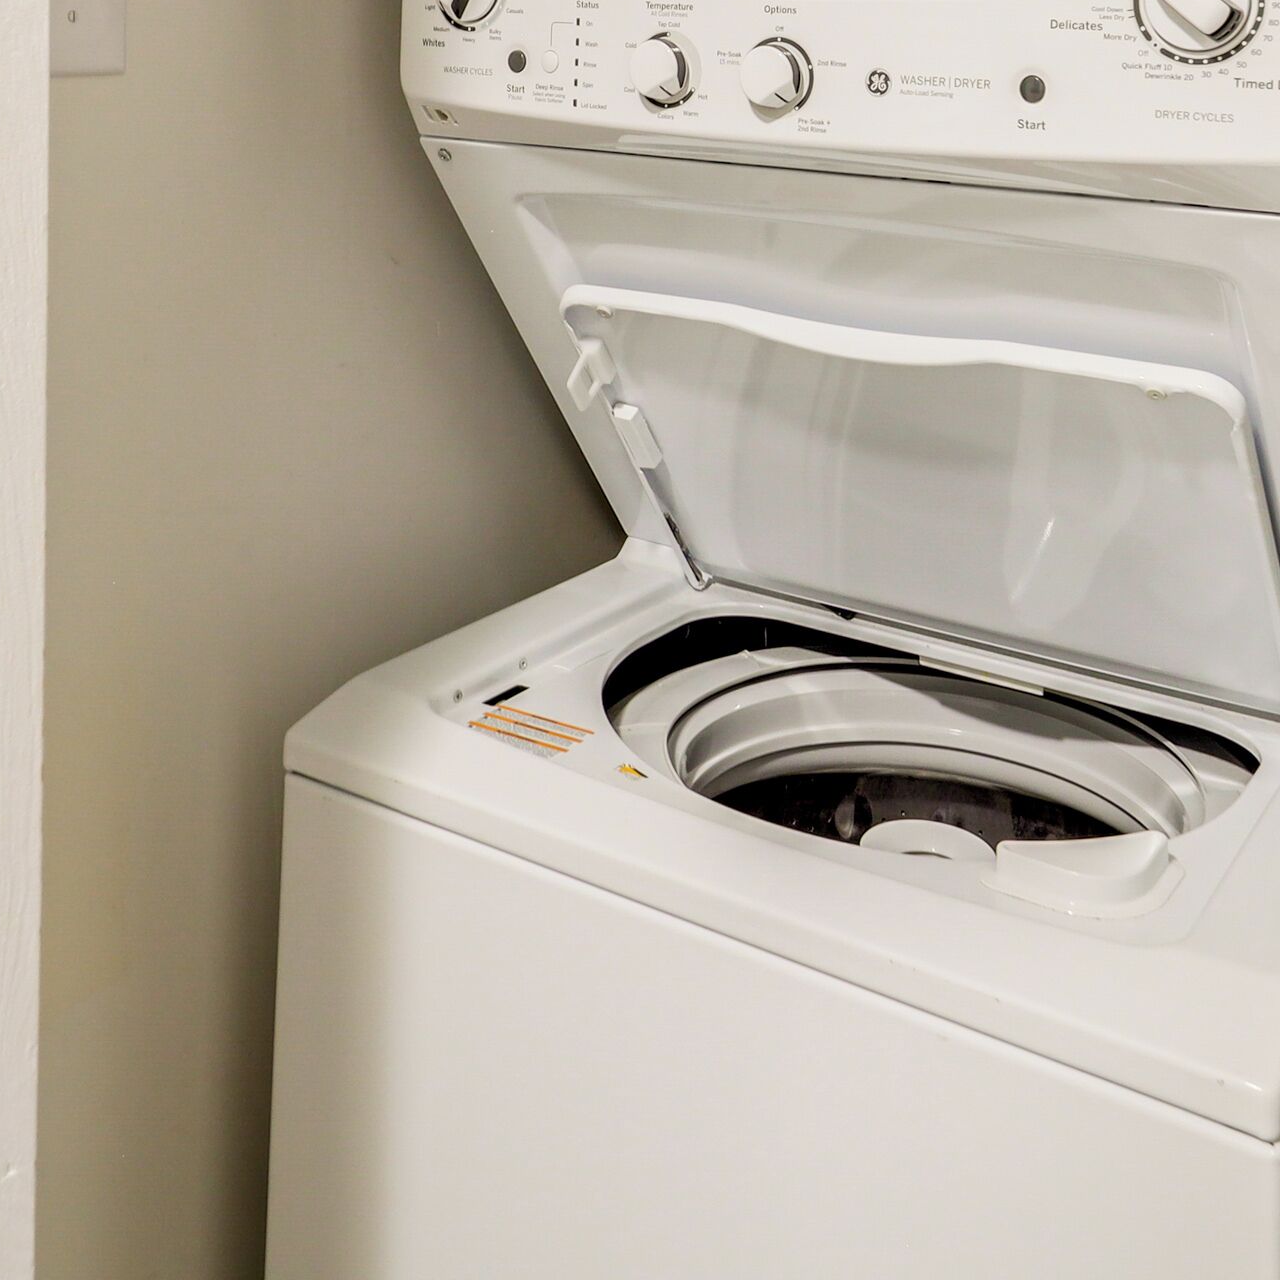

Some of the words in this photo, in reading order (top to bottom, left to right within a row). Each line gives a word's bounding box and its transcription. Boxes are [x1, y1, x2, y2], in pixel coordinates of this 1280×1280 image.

[576, 0, 600, 9] Status
[646, 1, 694, 12] Temperature
[763, 5, 797, 14] Options
[1050, 19, 1103, 31] Delicates
[422, 39, 445, 48] Whites
[443, 66, 468, 75] WASHER
[470, 67, 493, 76] CYCLES
[900, 75, 946, 87] WASHER
[954, 77, 991, 89] DRYER
[1234, 78, 1274, 90] Timed
[506, 84, 525, 93] Start
[1155, 109, 1190, 120] DRYER
[1193, 111, 1234, 123] CYCLES
[1017, 118, 1046, 130] Start
